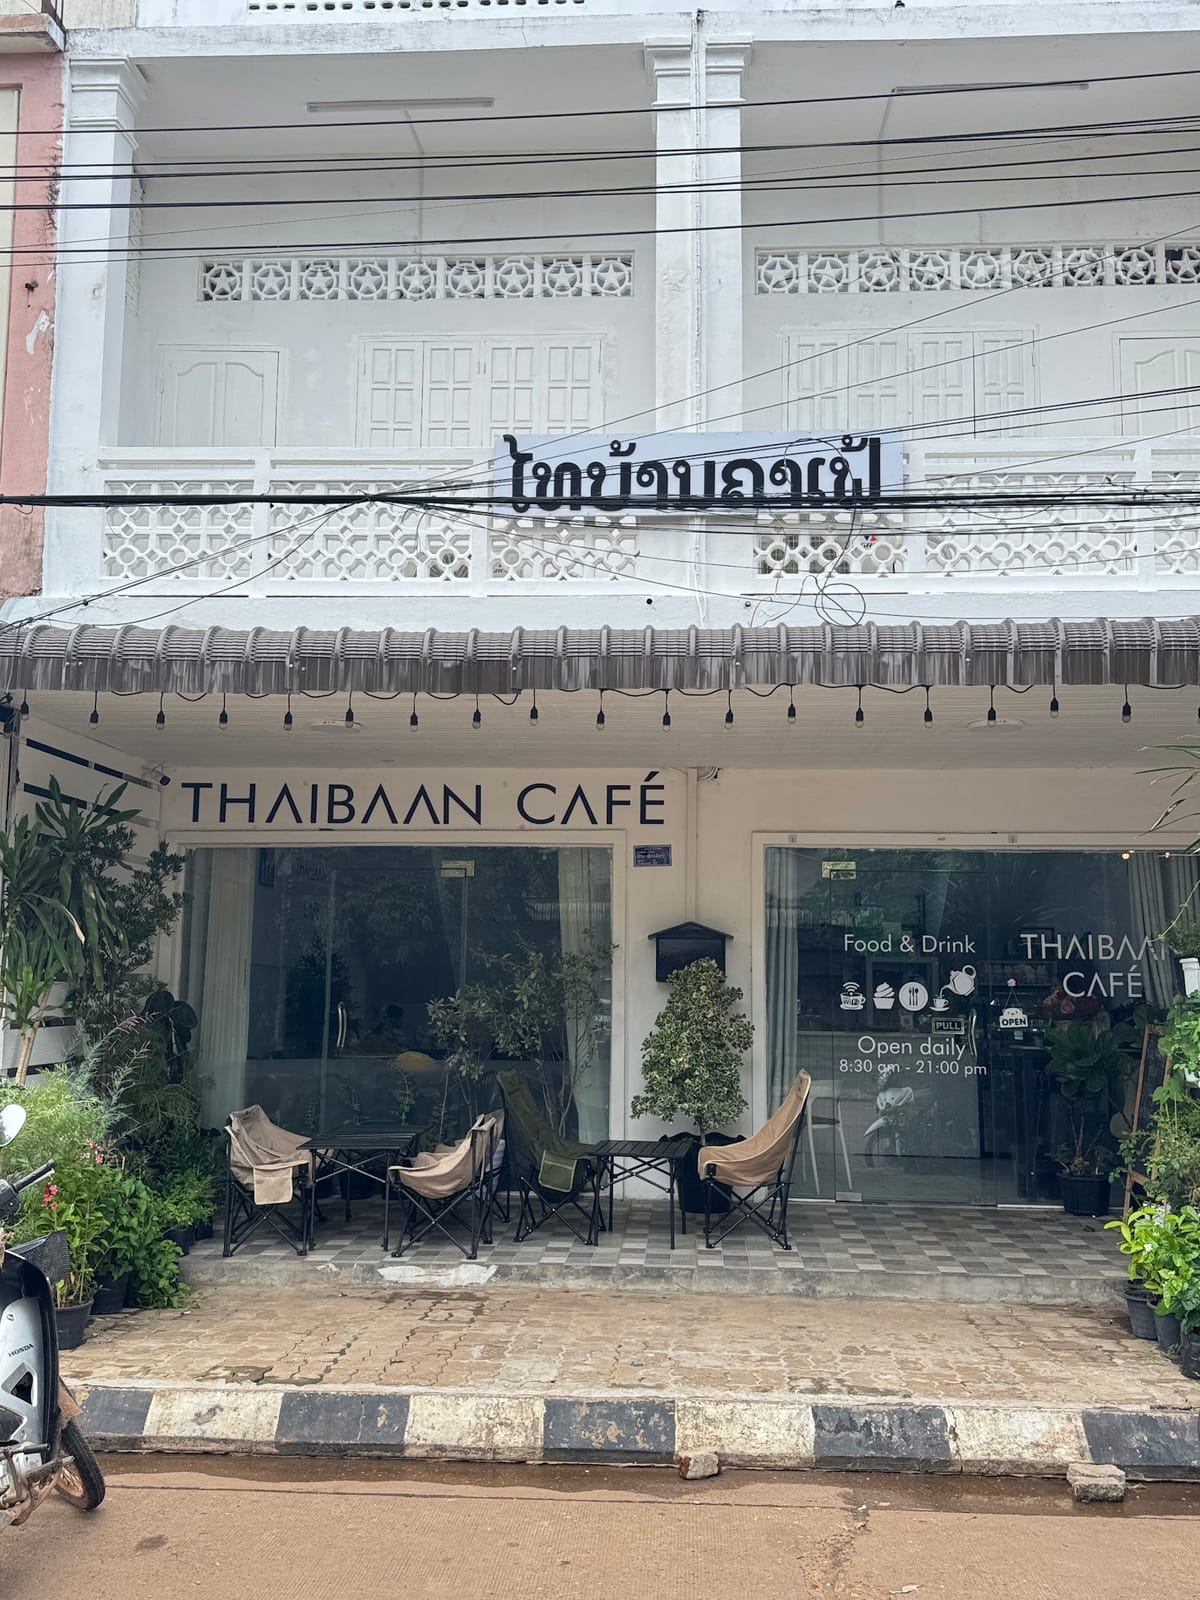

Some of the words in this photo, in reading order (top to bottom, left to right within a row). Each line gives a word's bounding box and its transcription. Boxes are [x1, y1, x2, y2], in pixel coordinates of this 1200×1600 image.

[181, 783, 482, 825] THAIBAAN
[516, 771, 666, 825] CAFÉ
[844, 933, 892, 952] Food
[900, 934, 914, 952] &
[922, 934, 976, 953] Drink
[1062, 965, 1143, 998] CAFÉ
[935, 1021, 961, 1030] PULL
[1001, 1018, 1027, 1026] OPEN
[857, 1035, 912, 1058] Open
[920, 1036, 966, 1060] daily
[839, 1059, 873, 1073] 8:30
[877, 1062, 900, 1073] am
[916, 1060, 959, 1074] 21:00
[964, 1064, 987, 1078] pm
[8, 1343, 34, 1357] HONDA
